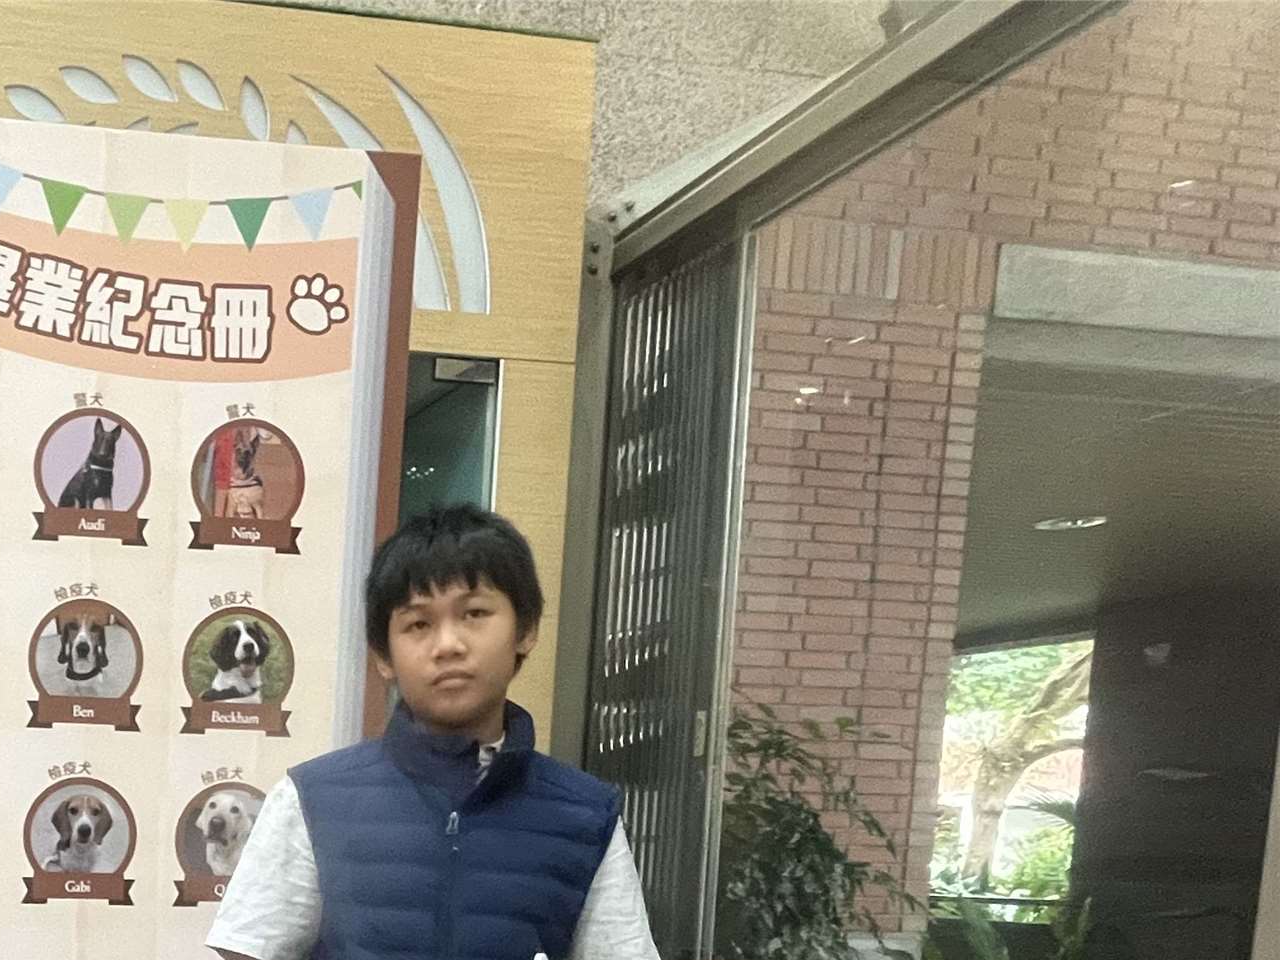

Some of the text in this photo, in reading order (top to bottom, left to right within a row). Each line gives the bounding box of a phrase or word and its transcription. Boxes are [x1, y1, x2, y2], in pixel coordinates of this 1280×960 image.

[78, 518, 105, 532] Audi
[231, 526, 261, 543] Ninja
[72, 705, 94, 718] Ben
[211, 711, 259, 725] Beckham
[64, 880, 91, 893] Gabi
